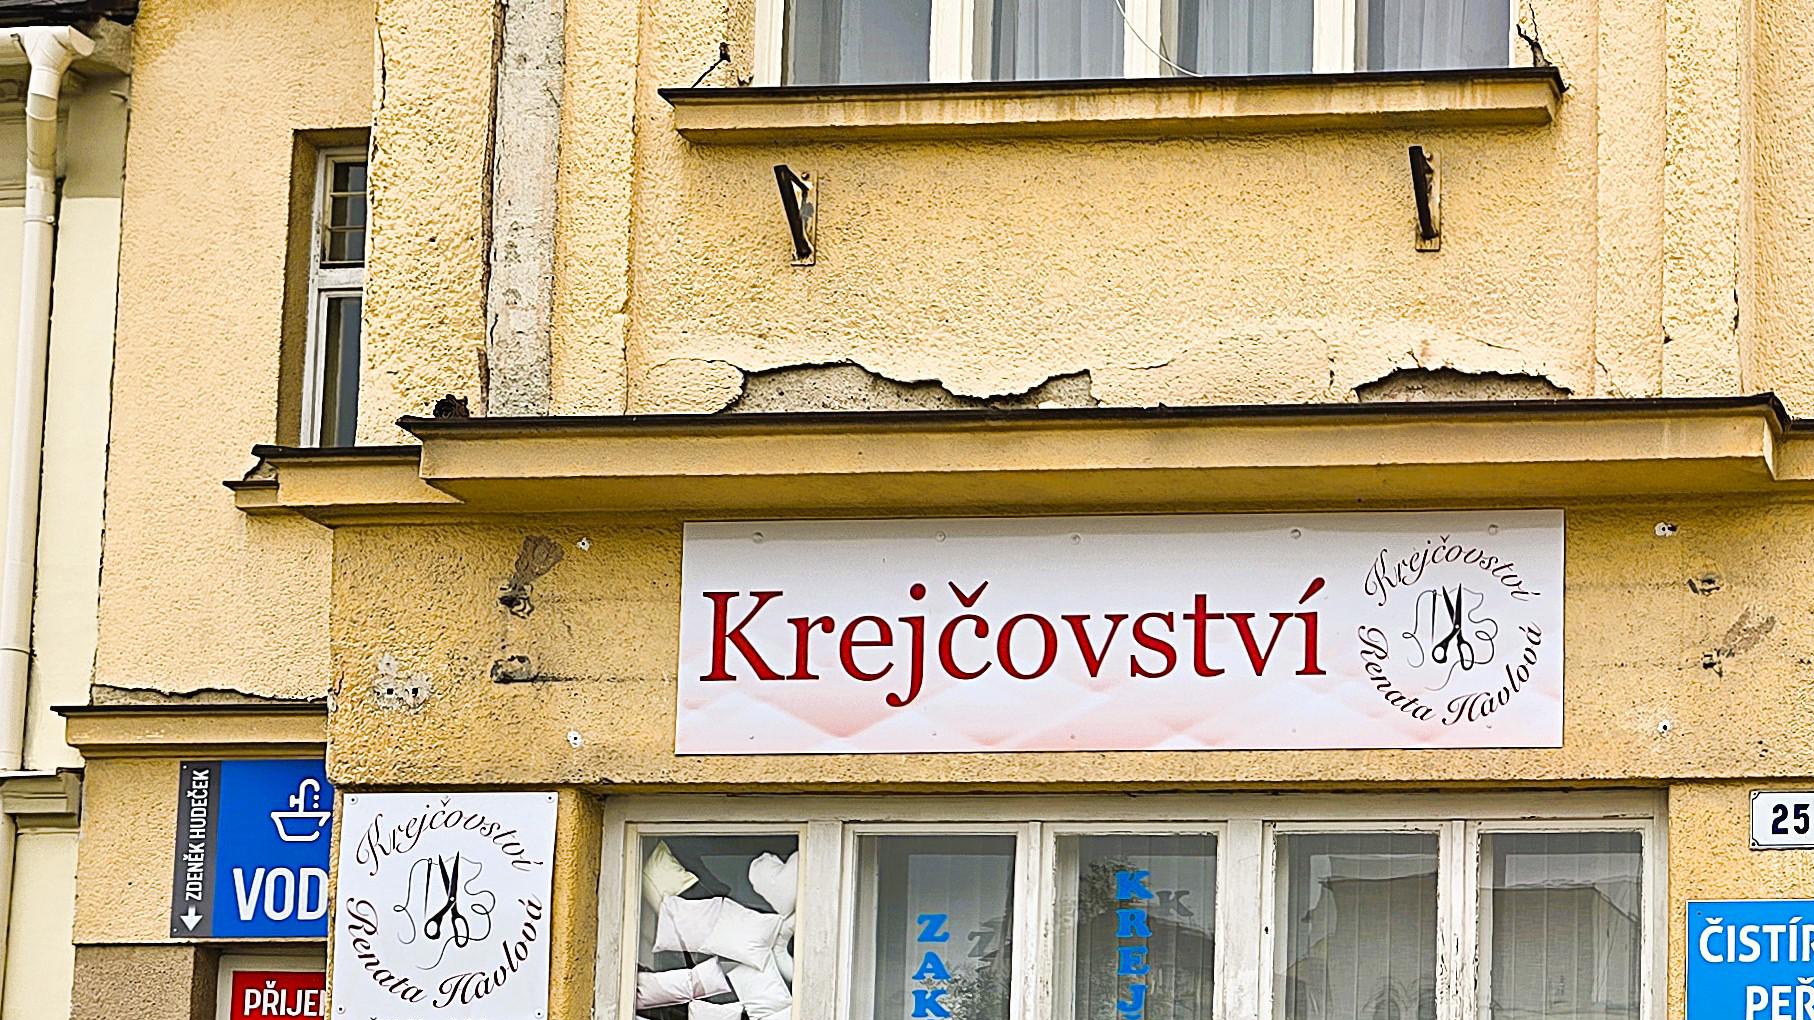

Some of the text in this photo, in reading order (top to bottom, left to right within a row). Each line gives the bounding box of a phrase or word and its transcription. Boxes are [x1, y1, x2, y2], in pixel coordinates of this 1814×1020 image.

[1364, 534, 1541, 607] Krejčovství
[700, 578, 1328, 708] Krejčovství
[1358, 621, 1543, 726] Renata Havlová
[183, 769, 210, 901] ZDENĚK HUDEČEK
[356, 795, 544, 876] Krejčovství
[1771, 803, 1811, 836] 25
[346, 892, 544, 1009] Renata Havlová
